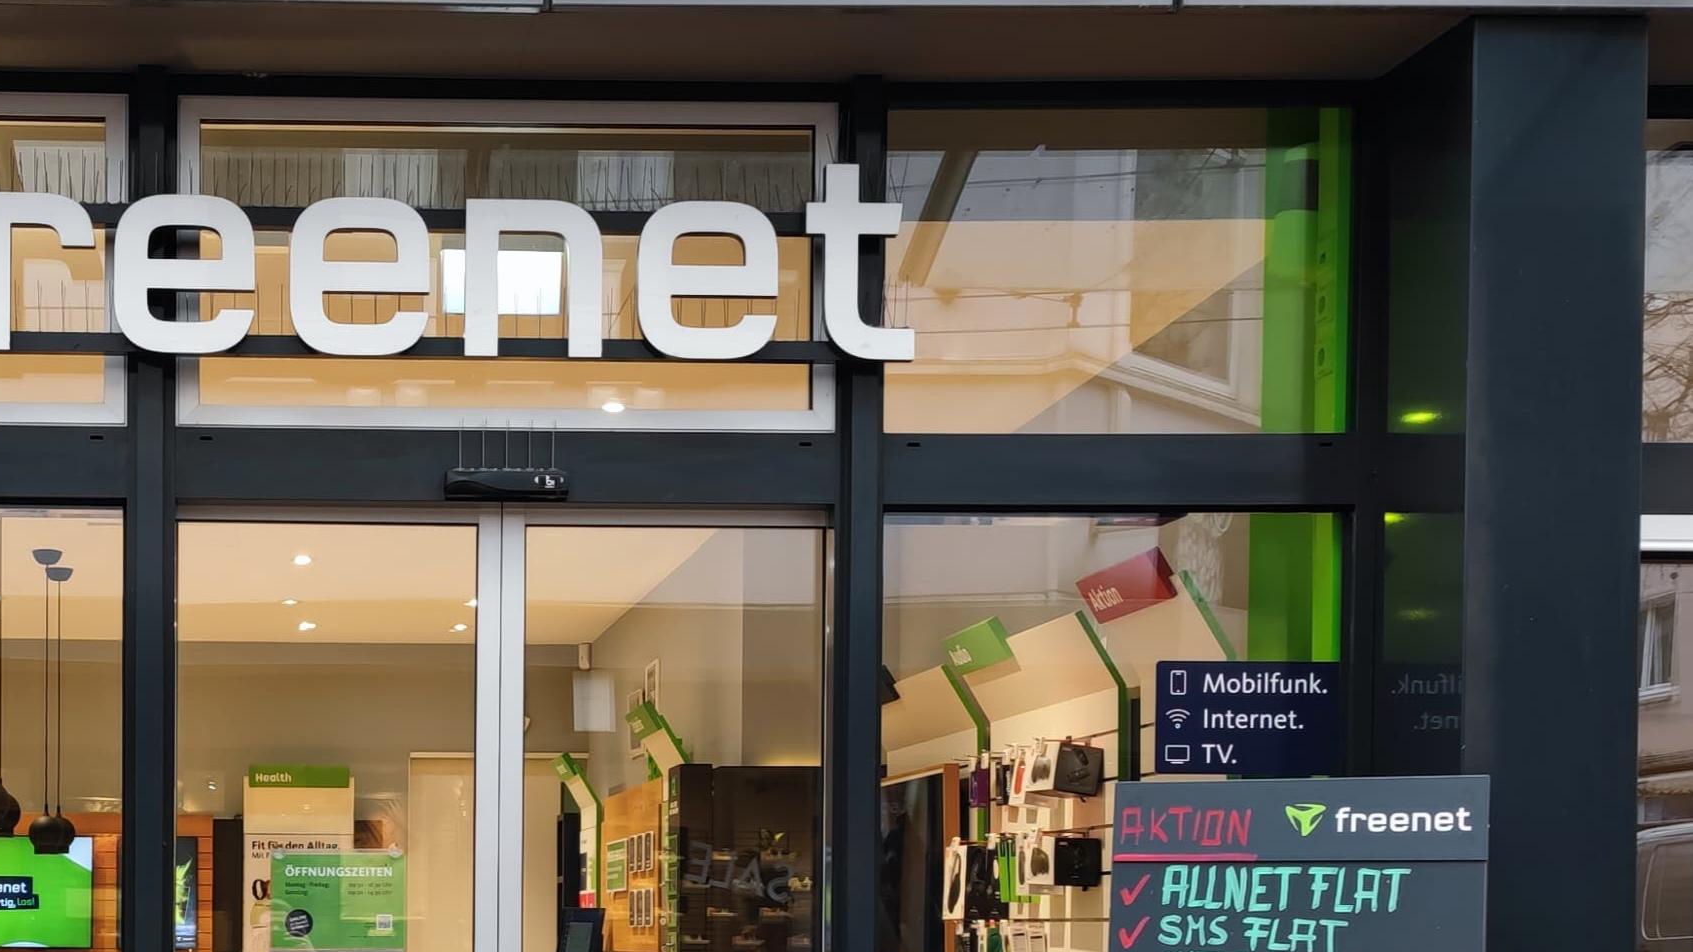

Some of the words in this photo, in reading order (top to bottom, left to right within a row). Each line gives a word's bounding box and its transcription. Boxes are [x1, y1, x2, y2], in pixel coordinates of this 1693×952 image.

[1087, 585, 1124, 612] Aktion
[1203, 671, 1328, 695] Mobilfunk.
[1203, 708, 1304, 730] Internet.
[1202, 744, 1238, 764] TV.
[255, 772, 292, 783] Health
[1120, 806, 1252, 847] AKTION
[1334, 806, 1473, 834] freenet
[252, 841, 265, 850] Fit
[285, 864, 393, 877] ÖFFNUNGSZEITEN
[1161, 865, 1301, 912] ALLNET
[1307, 867, 1412, 913] FLAT
[1158, 915, 1228, 946] SMS
